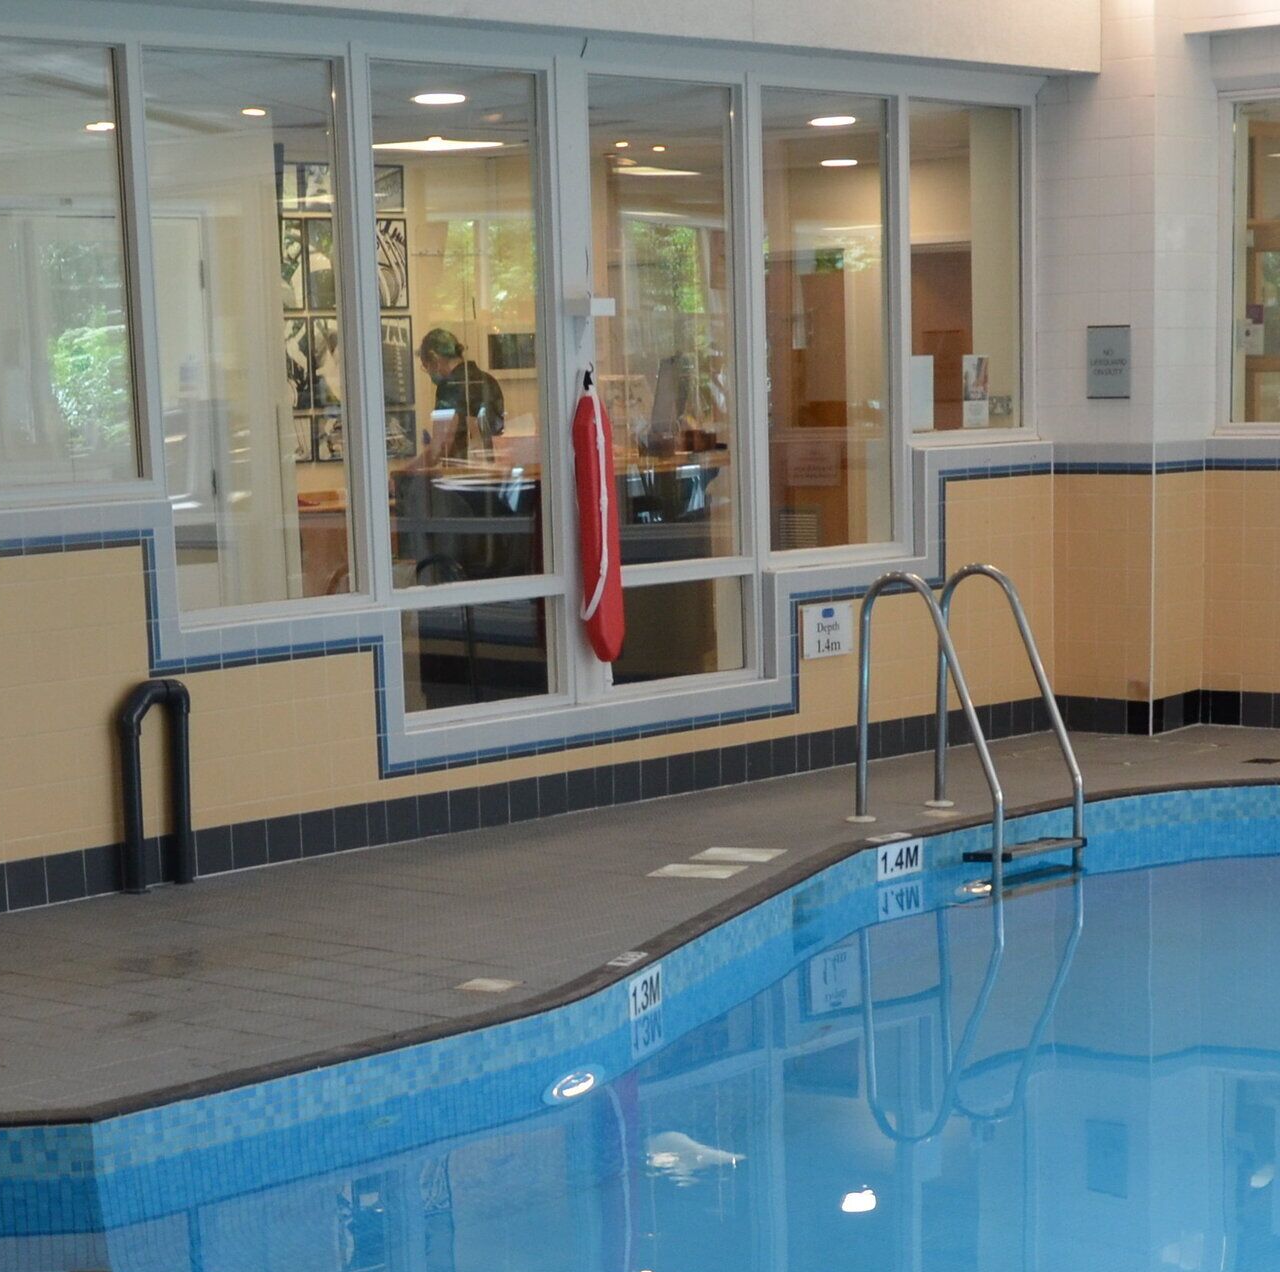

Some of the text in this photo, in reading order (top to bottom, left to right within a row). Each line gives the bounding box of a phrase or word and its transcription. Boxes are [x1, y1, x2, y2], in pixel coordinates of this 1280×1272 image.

[816, 621, 840, 635] Depth
[816, 639, 841, 653] 1.4m
[881, 845, 919, 874] 1.4M
[632, 971, 660, 1016] 1.3M
